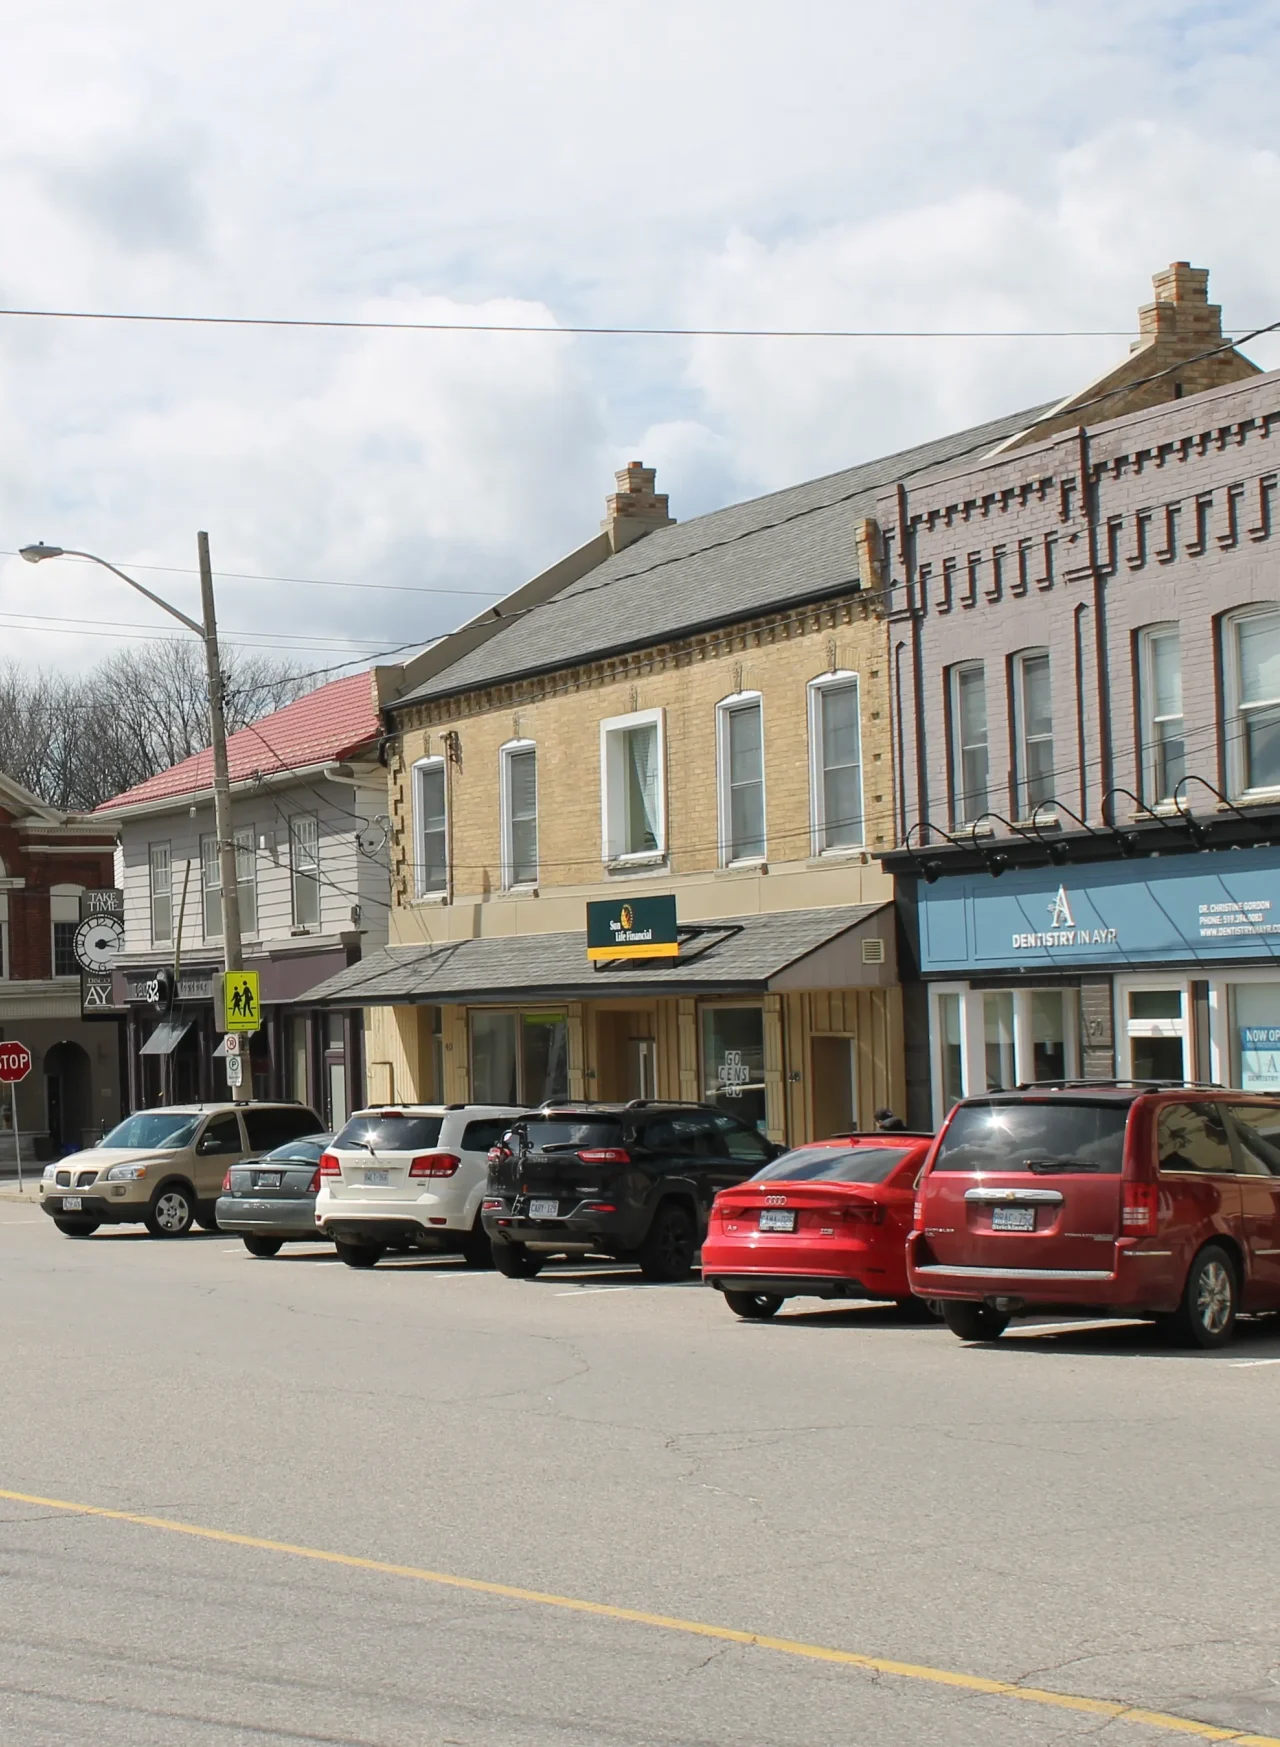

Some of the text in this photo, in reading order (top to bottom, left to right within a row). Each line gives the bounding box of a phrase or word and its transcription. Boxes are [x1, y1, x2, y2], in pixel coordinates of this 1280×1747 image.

[88, 892, 117, 902] TAKE
[87, 901, 119, 911] TIME
[1210, 902, 1243, 912] CHRISTINE
[1244, 900, 1270, 911] GORDON
[609, 919, 621, 930] Sun
[615, 929, 652, 942] Life Financial
[1012, 928, 1117, 949] DENTISTRY IN AYR
[1246, 1030, 1267, 1042] NOW
[726, 1052, 740, 1066] GO
